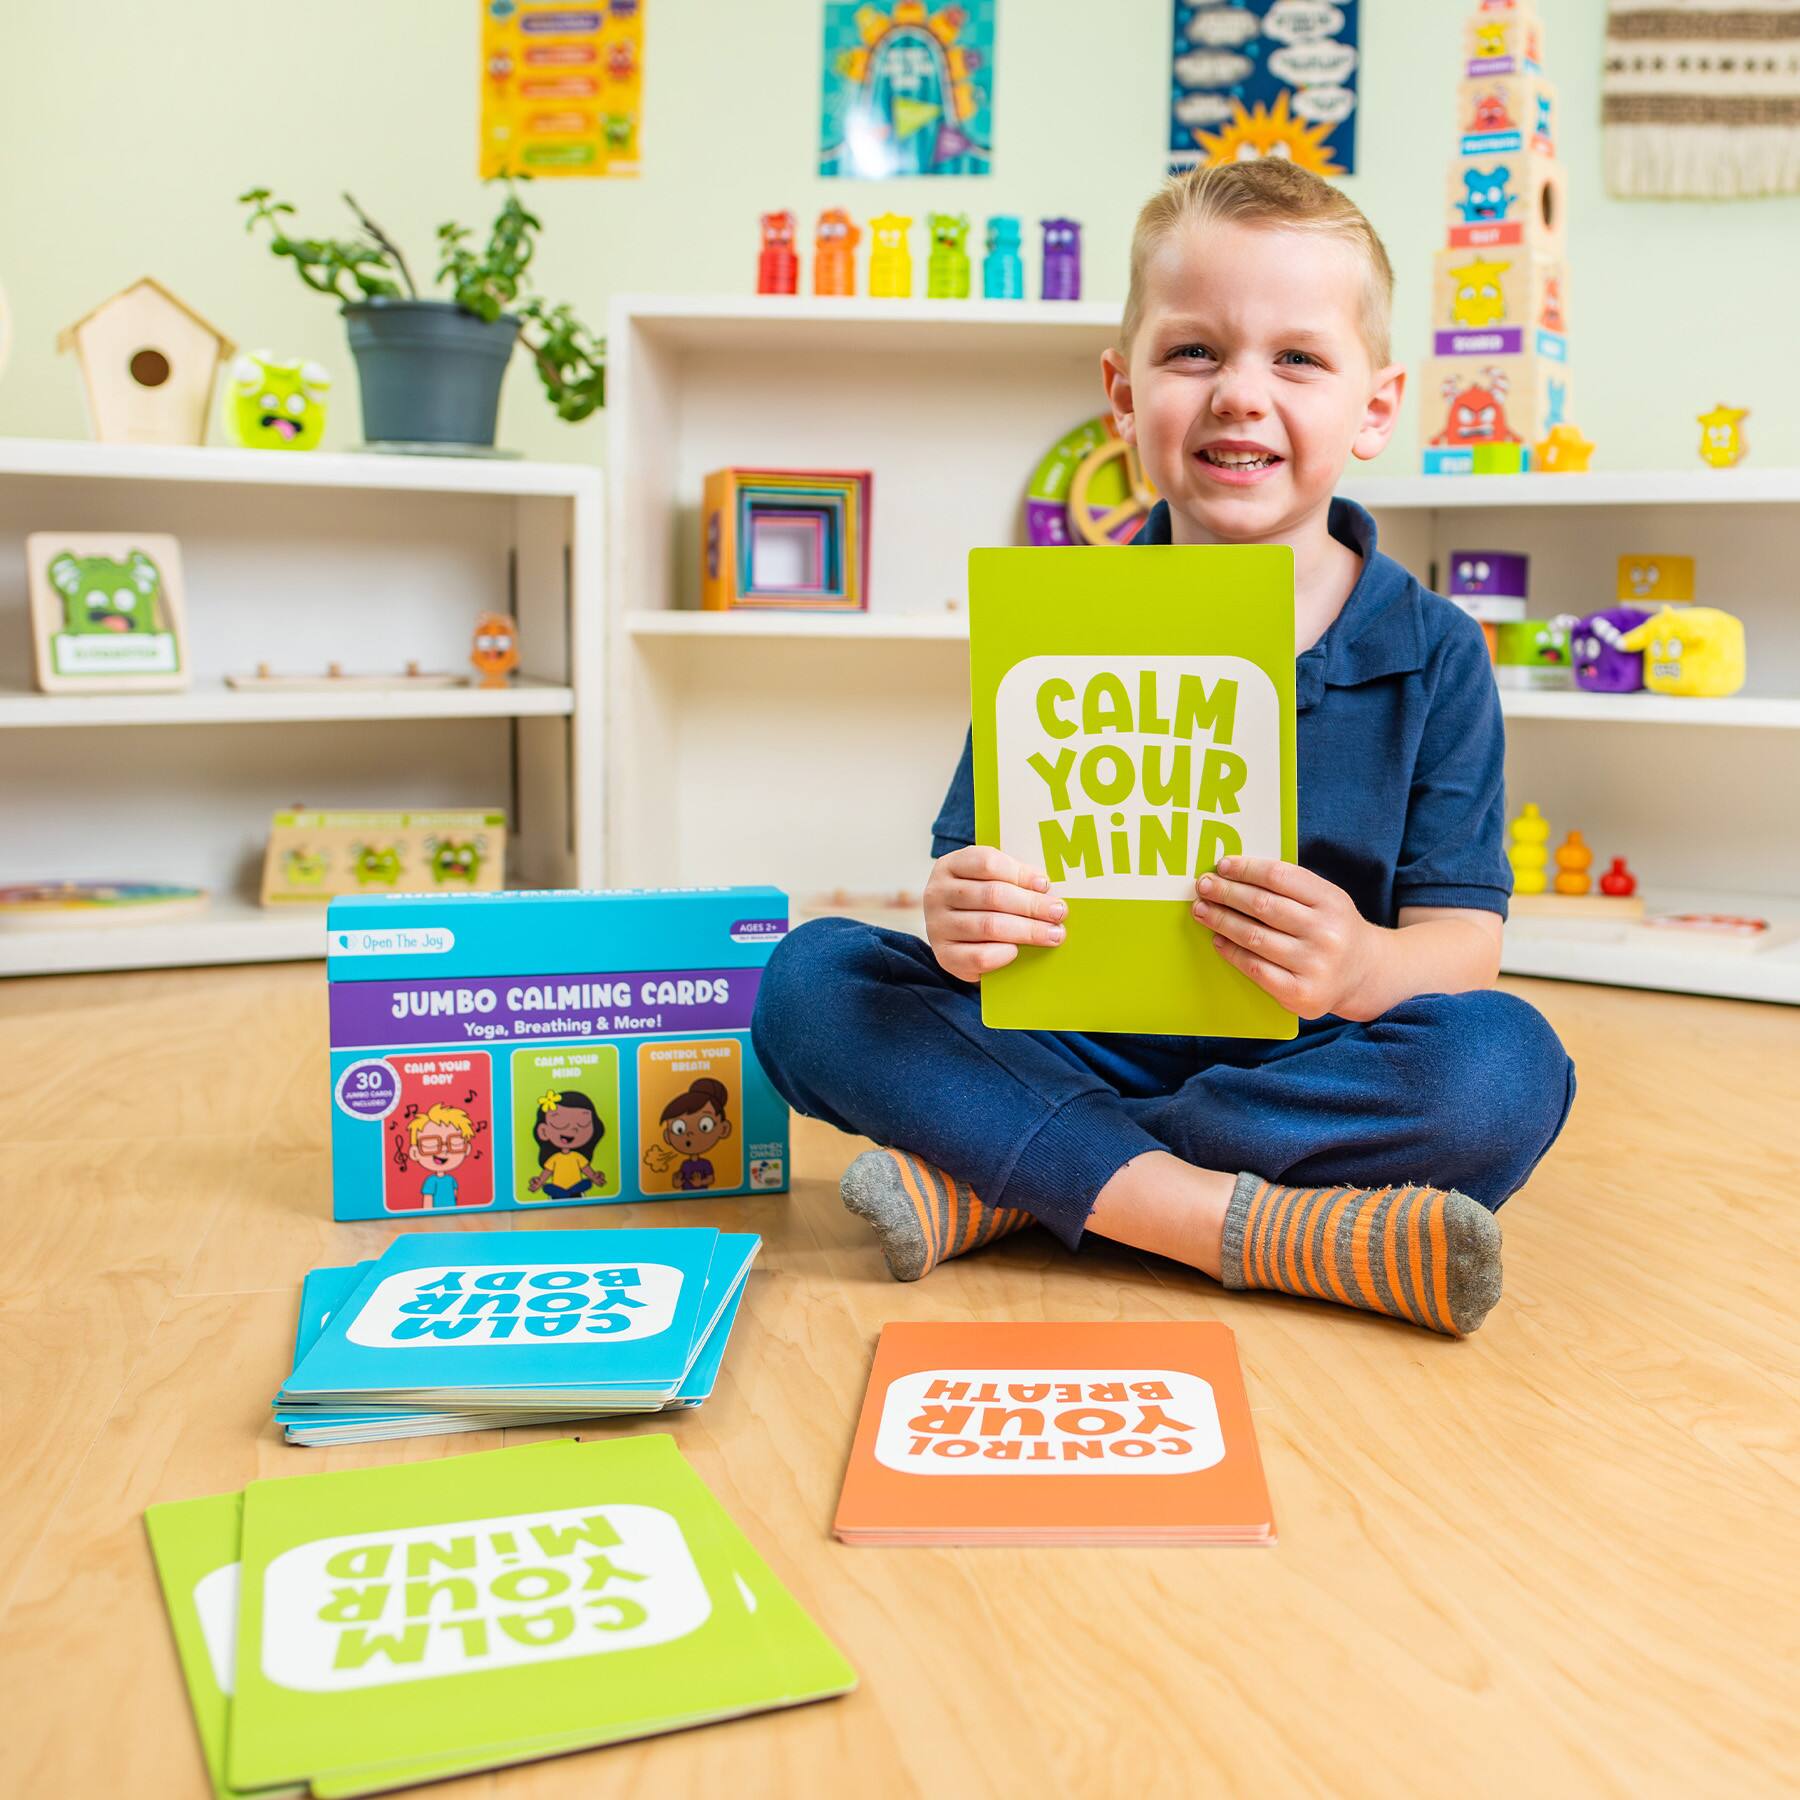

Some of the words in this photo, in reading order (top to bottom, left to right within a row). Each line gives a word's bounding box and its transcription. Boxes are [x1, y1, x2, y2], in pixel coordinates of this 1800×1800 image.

[1036, 670, 1239, 745] CALM
[1025, 744, 1248, 815] YOUR
[740, 923, 764, 933] AGES
[765, 922, 777, 932] 2+
[363, 935, 392, 951] Open
[397, 934, 417, 948] The
[422, 934, 443, 949] Joy
[392, 988, 498, 1019] JUMBO
[506, 982, 632, 1011] CALMING
[640, 978, 729, 1006] CARDS
[464, 1022, 509, 1040] Yoga,
[514, 1018, 592, 1035] Breathing
[596, 1016, 609, 1031] &
[614, 1014, 662, 1029] More!
[534, 1056, 565, 1067] CALM
[567, 1054, 599, 1065] YOUR
[650, 1050, 698, 1061] CONTROL
[701, 1047, 731, 1058] YOUR
[671, 1061, 710, 1072] BREATH
[404, 1062, 435, 1074] CALM
[438, 1060, 471, 1072] YOUR
[552, 1067, 582, 1079] MIND
[356, 1071, 382, 1090] 30
[422, 1074, 454, 1086] BODY
[415, 1267, 642, 1292] BODY
[398, 1289, 649, 1316] YOUR
[390, 1312, 632, 1340] CALM
[922, 1379, 1175, 1403] BREATH
[907, 1404, 1197, 1437] YOUR
[908, 1436, 1193, 1461] CONTROL
[317, 1554, 651, 1623] YOUR
[330, 1595, 649, 1671] CALM
